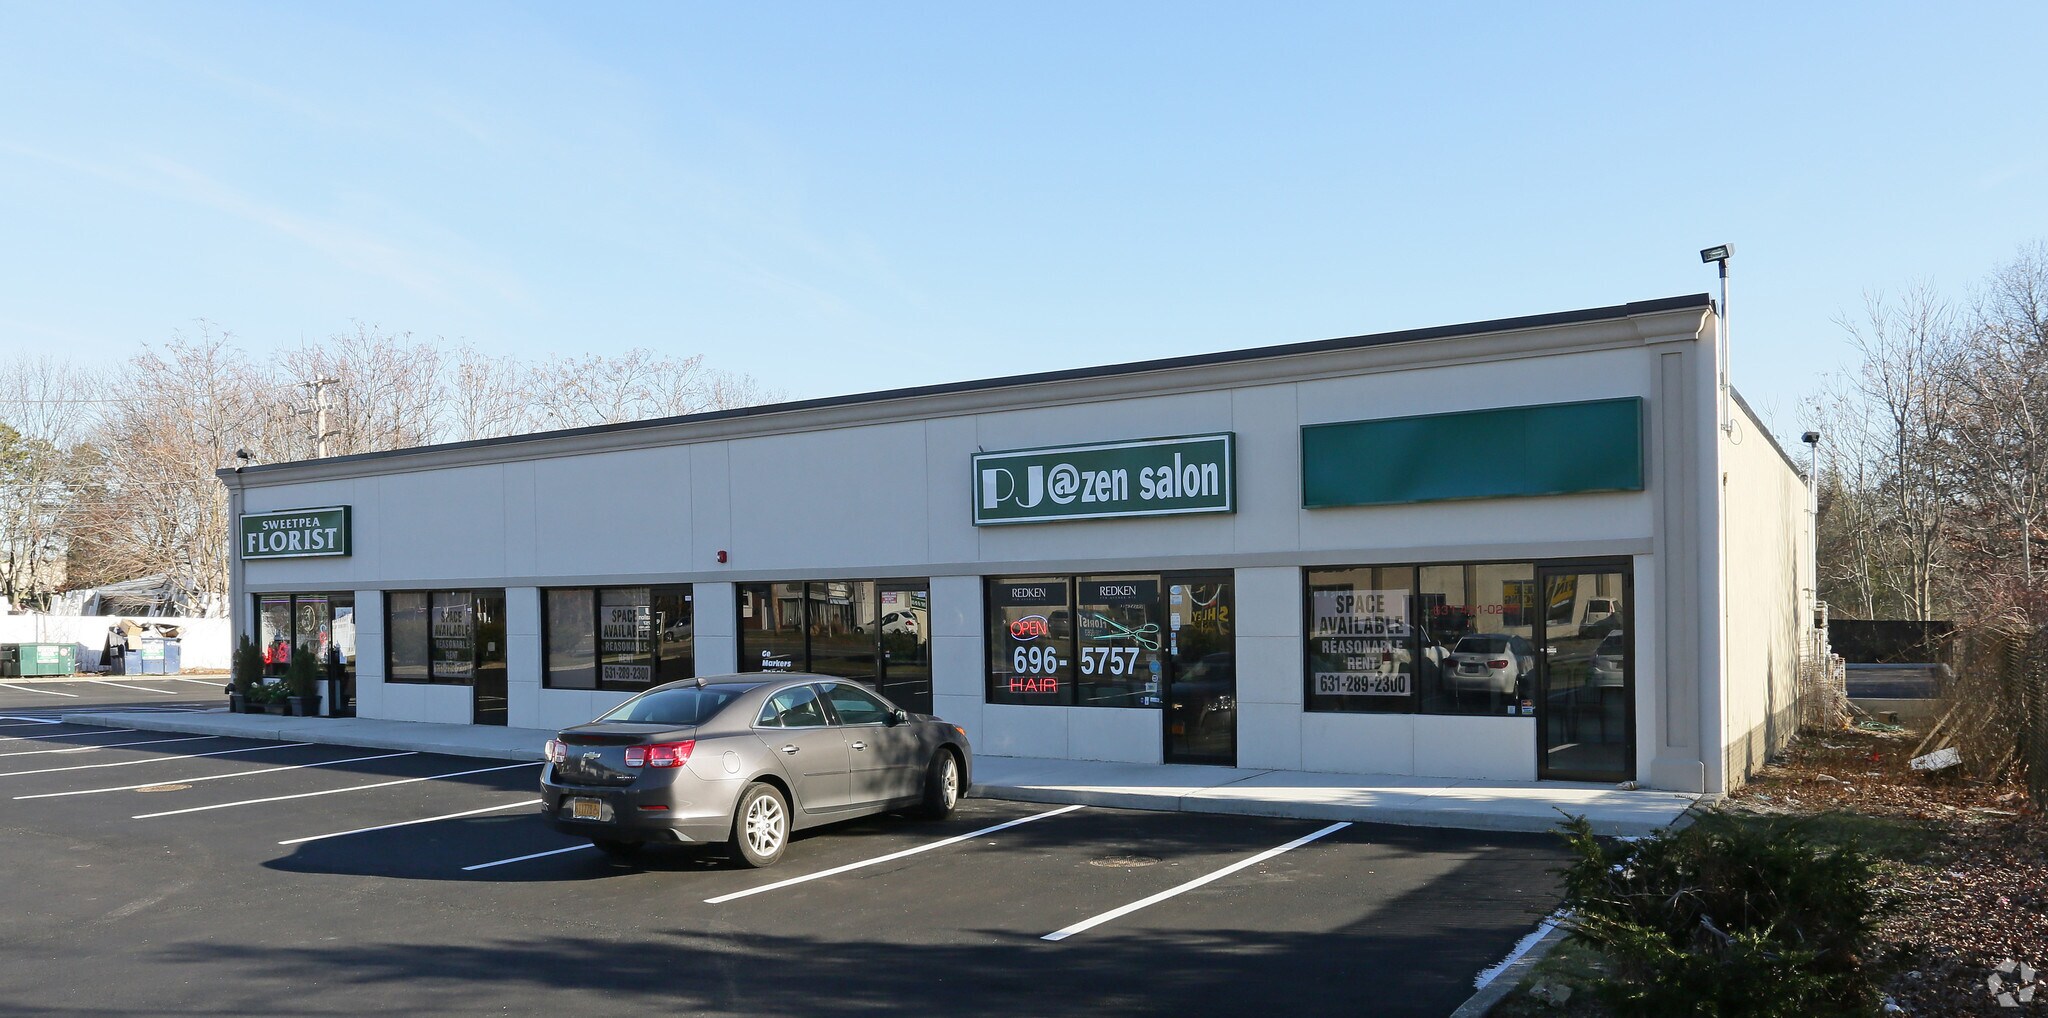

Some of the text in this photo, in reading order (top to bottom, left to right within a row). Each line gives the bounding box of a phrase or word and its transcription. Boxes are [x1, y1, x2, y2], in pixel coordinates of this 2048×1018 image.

[1139, 452, 1219, 500] salon
[262, 517, 321, 531] SWEETPEA
[247, 527, 338, 553] FLORIST
[1011, 587, 1047, 598] REDKEN
[1099, 585, 1137, 596] REDKEN
[1336, 595, 1385, 614] SPACE
[440, 611, 463, 623] SPACE
[611, 609, 638, 623] SPACE
[434, 625, 471, 636] AVAILABLE
[603, 624, 648, 638] AVAILABLE
[1010, 620, 1047, 637] OPEN
[1319, 615, 1404, 635] AVAILABLE
[605, 641, 648, 652] REASONABLE
[1322, 639, 1403, 654] REASONABLE
[618, 653, 634, 664] RENT
[762, 660, 792, 668] Markers
[1080, 647, 1140, 675] 5757
[1347, 656, 1377, 670] RENT
[1010, 678, 1057, 693] HAIR
[1320, 674, 1406, 694] 631-289-2300
